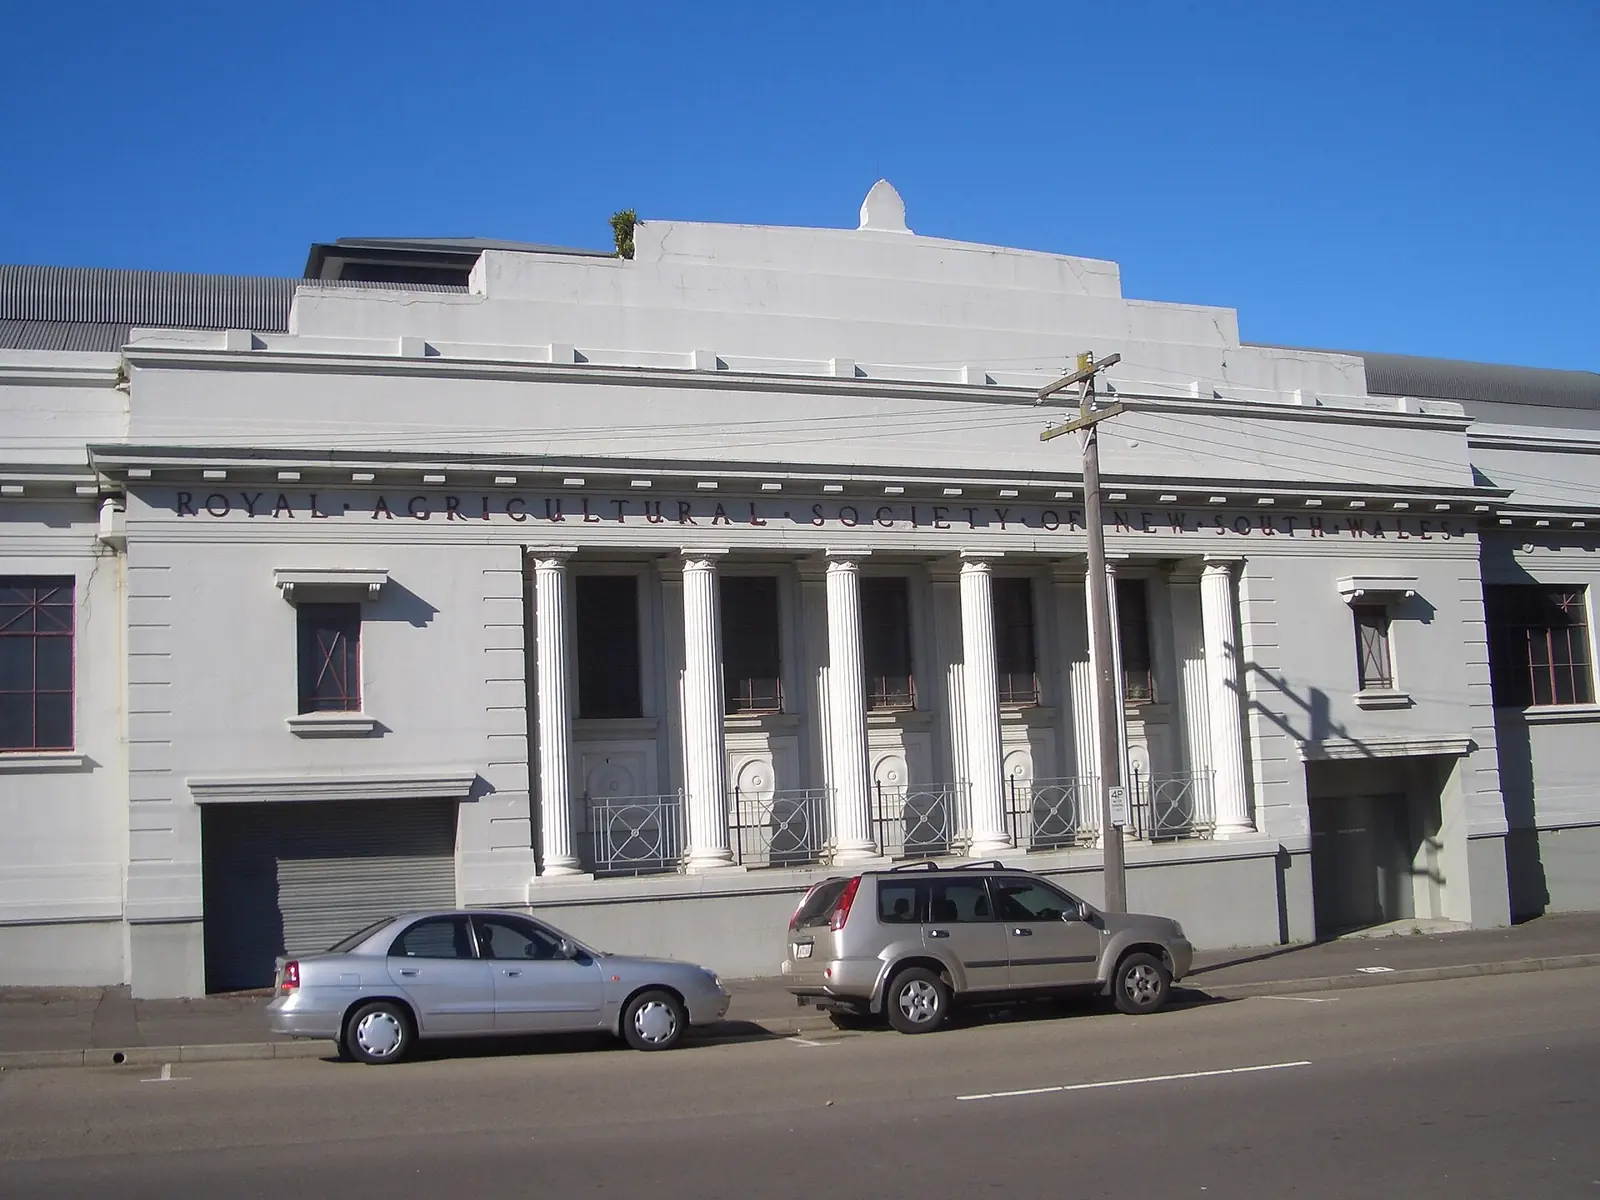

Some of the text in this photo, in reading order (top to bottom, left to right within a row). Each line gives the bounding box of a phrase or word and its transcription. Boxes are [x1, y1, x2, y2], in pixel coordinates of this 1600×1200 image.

[176, 492, 1452, 541] ROYAL AGRICULTURAL SOCIETY OF NEW SOUTH WALES
[1111, 790, 1123, 798] 4P
